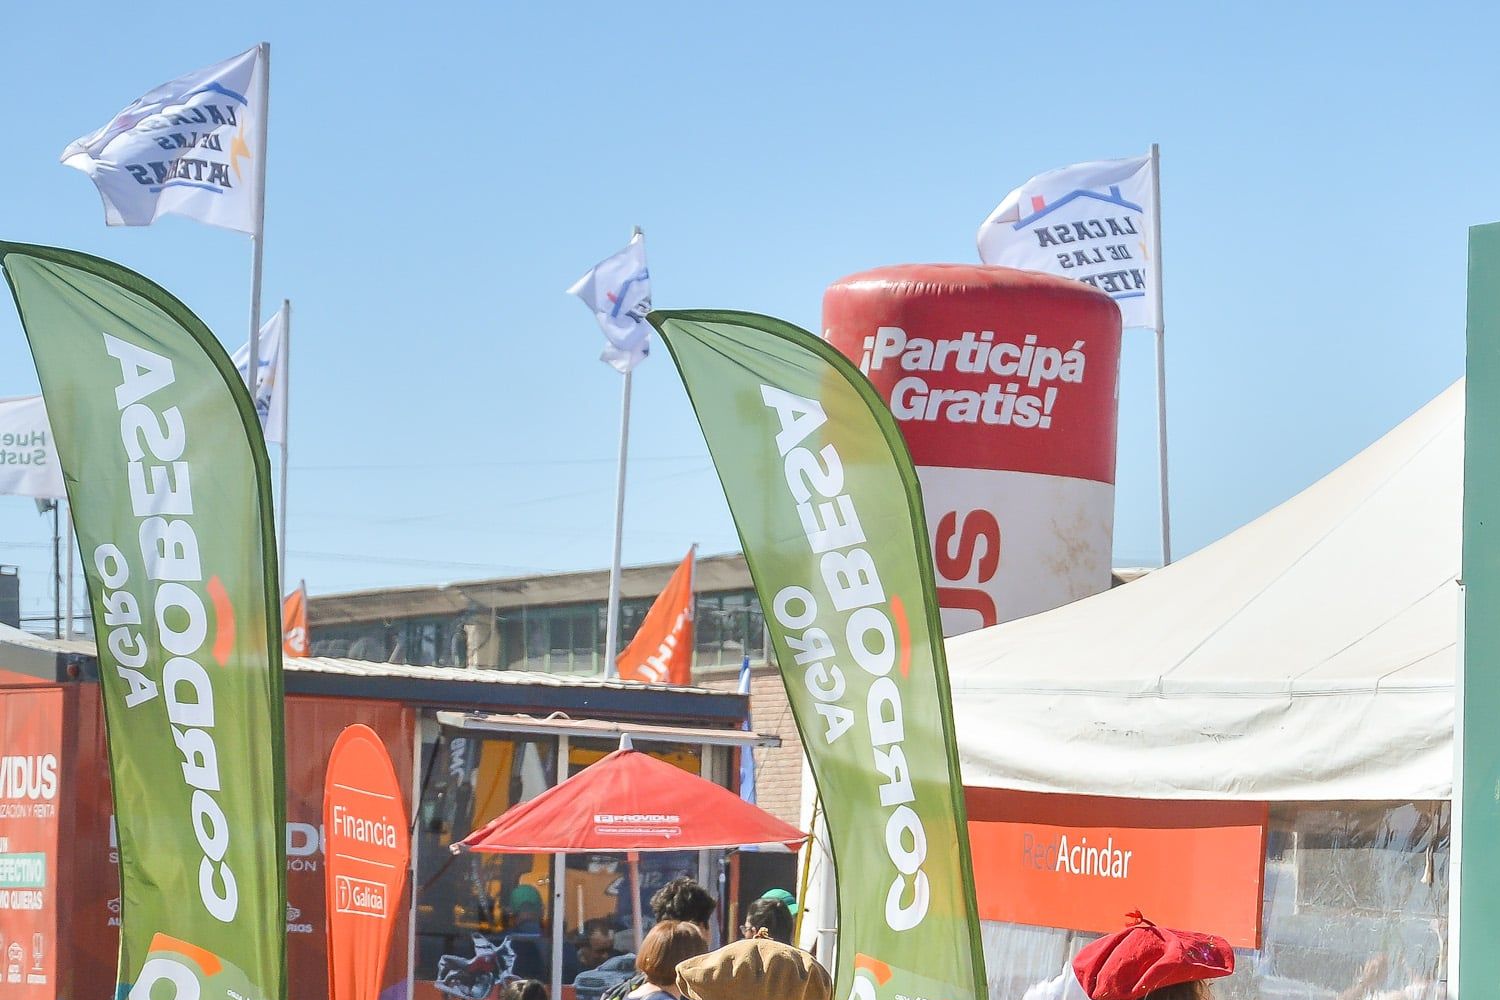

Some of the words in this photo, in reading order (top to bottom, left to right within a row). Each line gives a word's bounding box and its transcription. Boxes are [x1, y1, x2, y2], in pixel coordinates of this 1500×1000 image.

[860, 326, 1086, 388] ¡Participá
[889, 376, 1058, 430] Gratis!
[333, 805, 397, 849] Financia
[352, 885, 384, 910] Galicia
